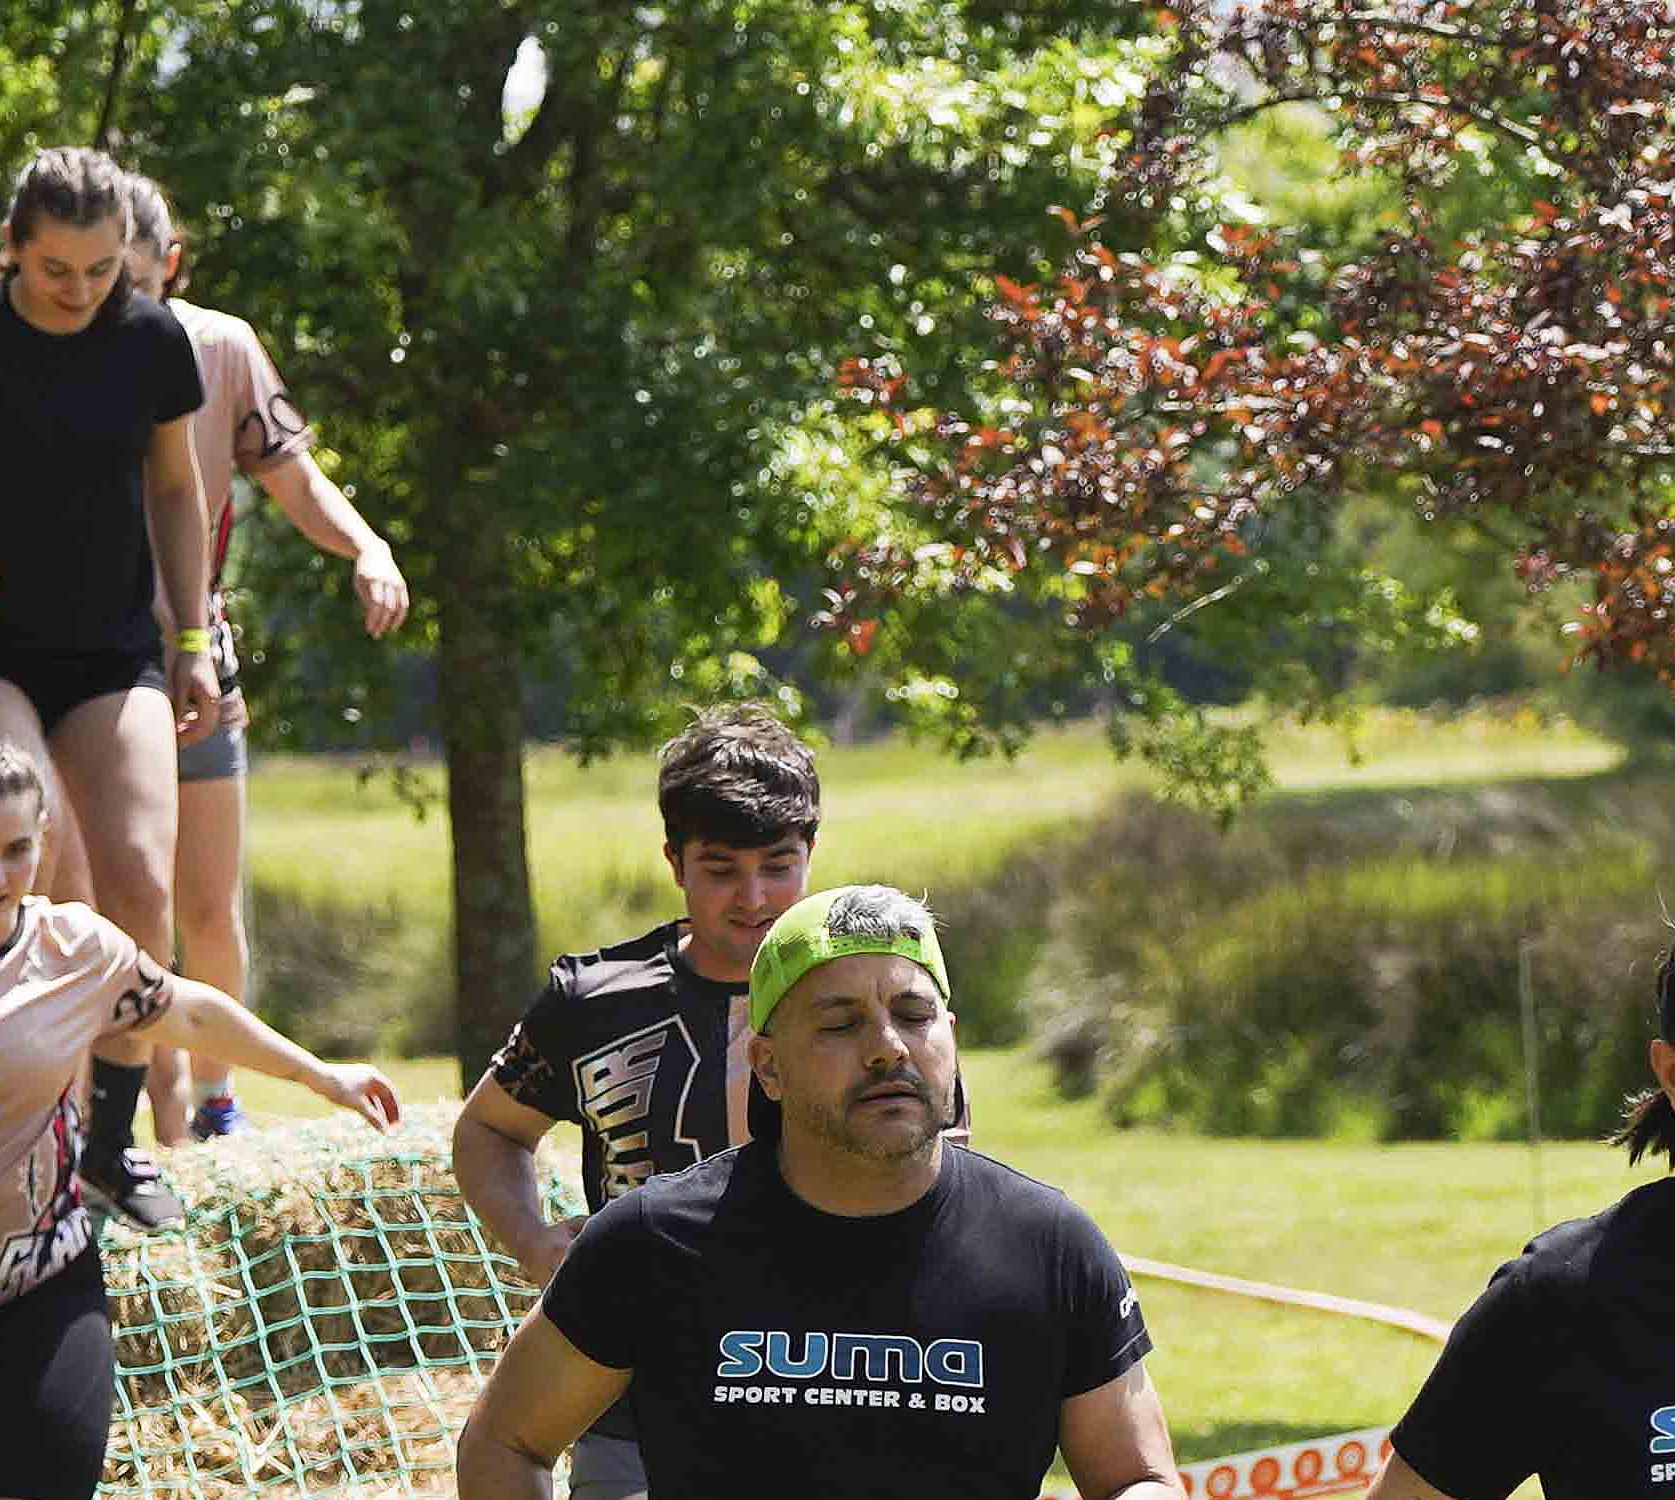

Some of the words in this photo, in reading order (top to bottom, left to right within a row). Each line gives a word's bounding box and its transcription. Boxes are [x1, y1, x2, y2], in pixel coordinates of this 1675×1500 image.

[713, 1385, 797, 1405] SPORT
[804, 1387, 901, 1409] CENTER
[908, 1392, 927, 1411] &
[934, 1393, 987, 1415] BOX
